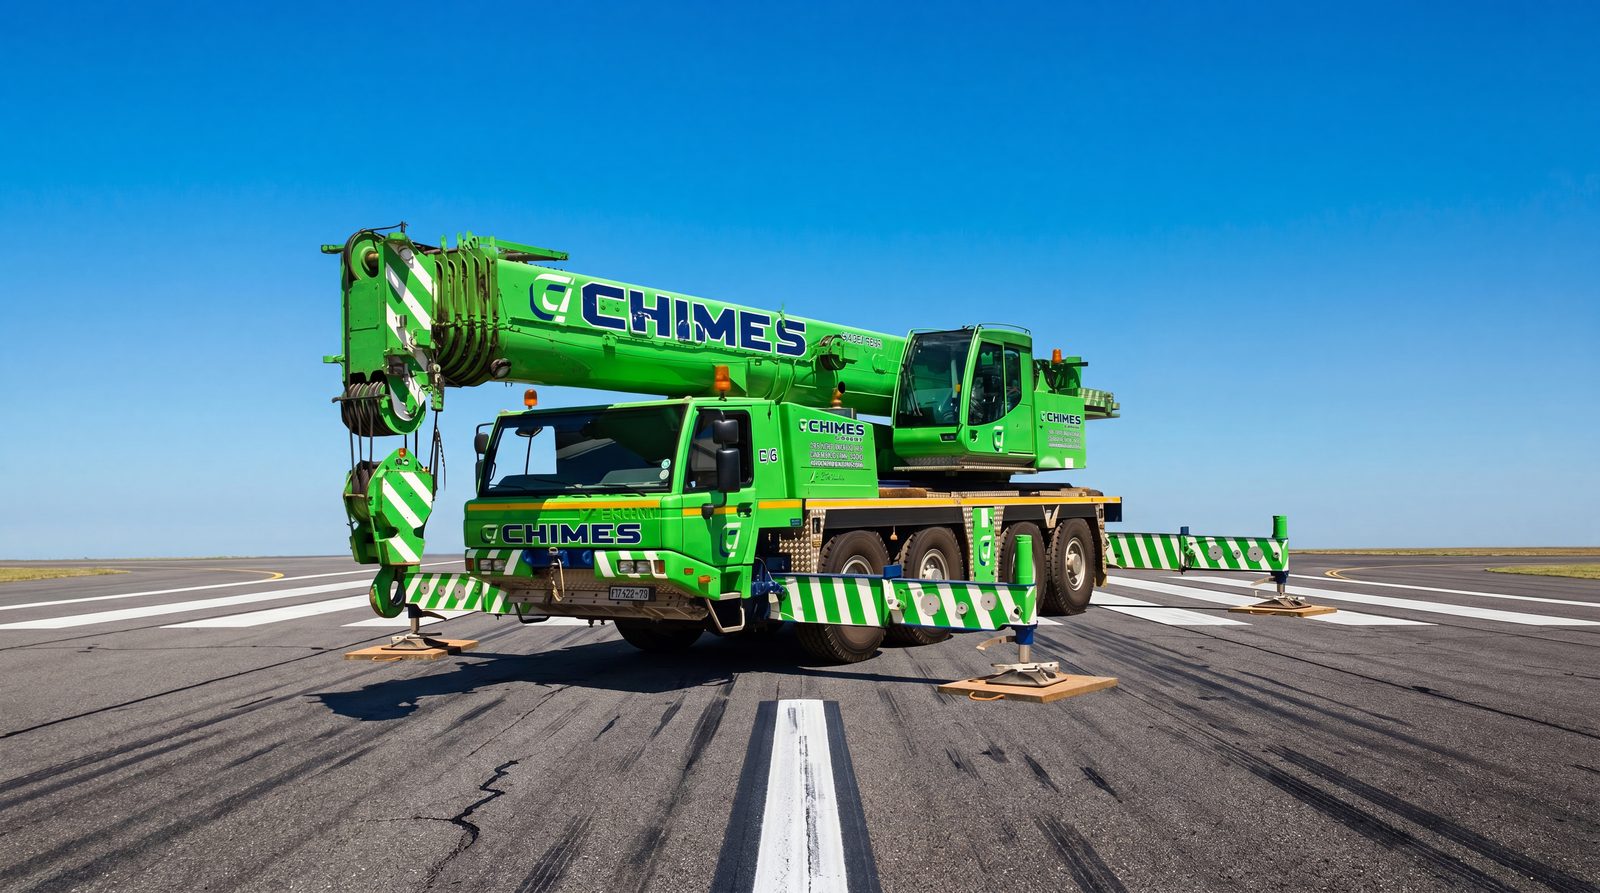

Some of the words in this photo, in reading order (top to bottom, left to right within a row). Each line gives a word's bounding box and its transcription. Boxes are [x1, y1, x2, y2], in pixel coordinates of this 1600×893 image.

[581, 281, 807, 357] CHIMES
[808, 420, 865, 436] CHIMES
[1046, 412, 1082, 425] CHIMES
[501, 522, 643, 545] CHIMES
